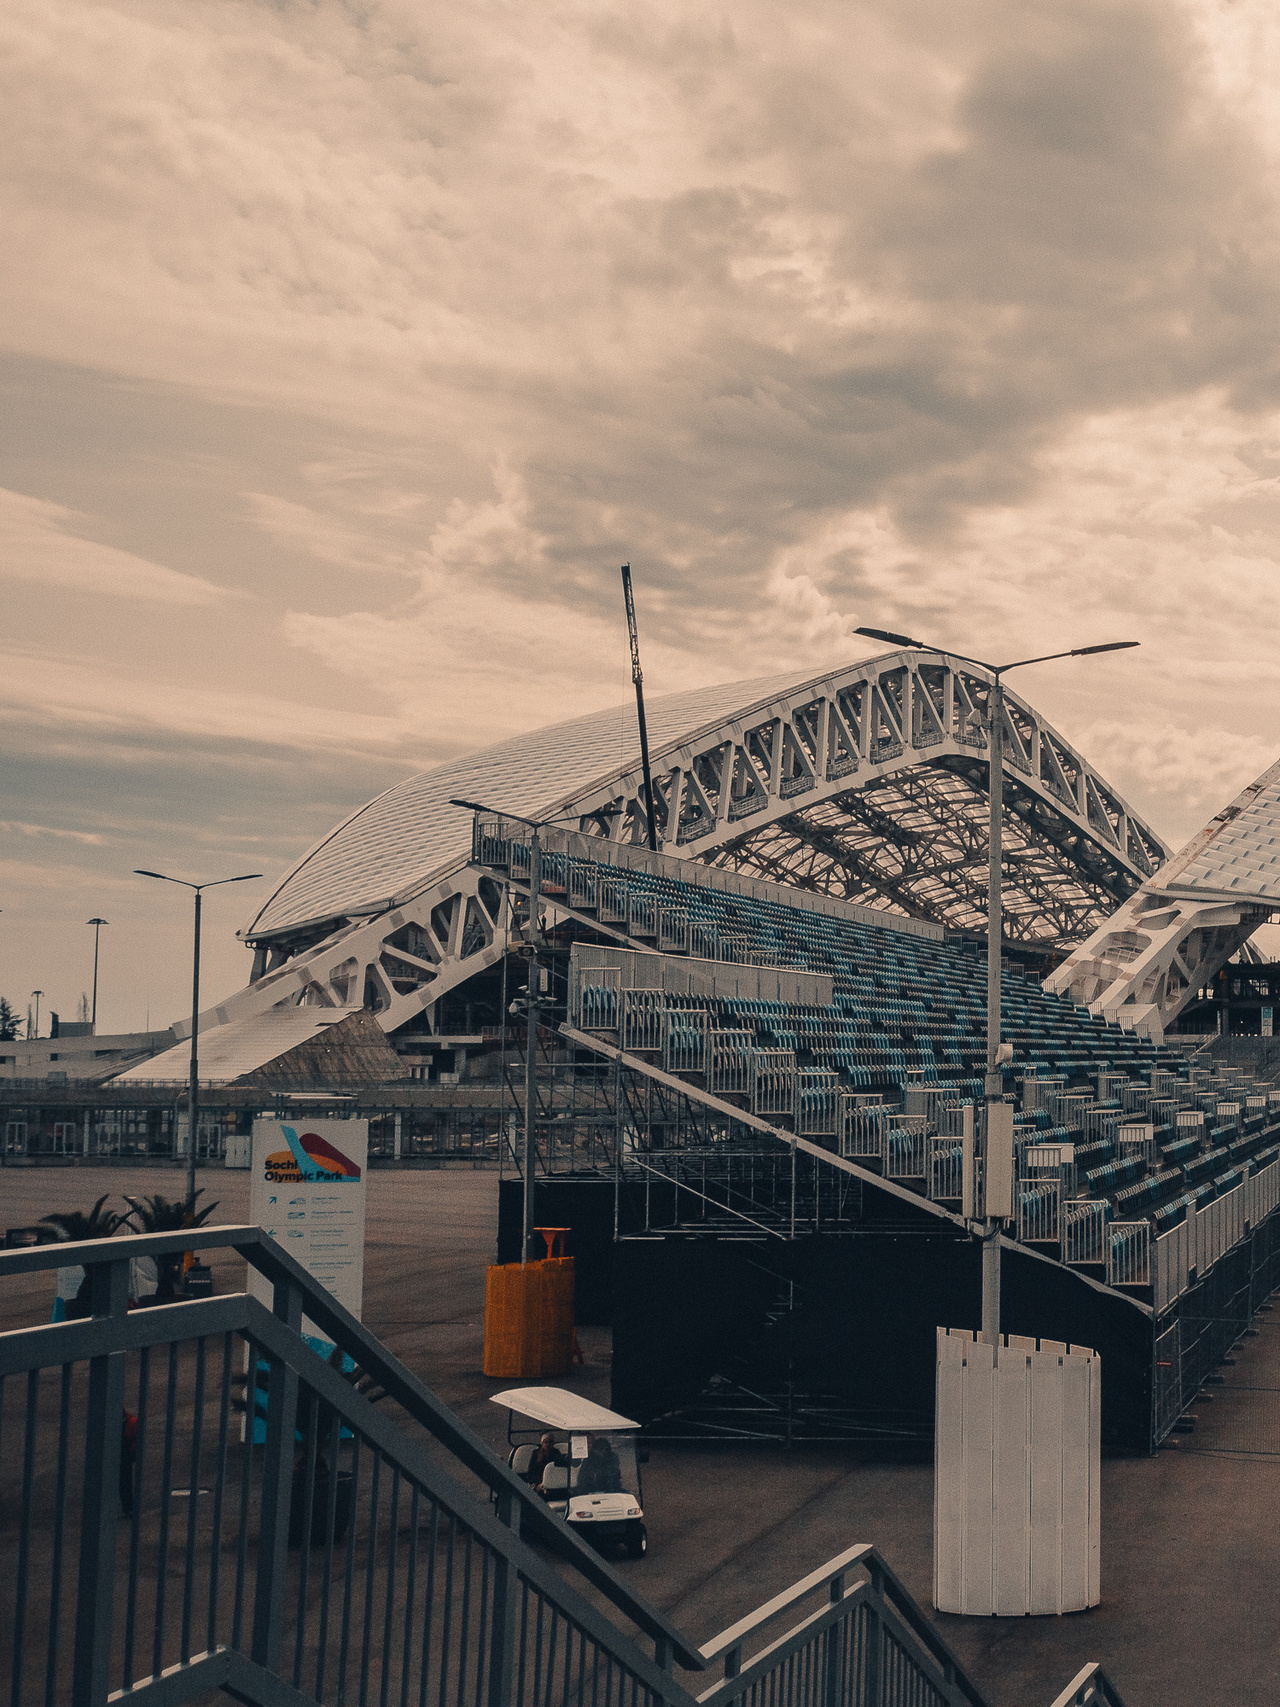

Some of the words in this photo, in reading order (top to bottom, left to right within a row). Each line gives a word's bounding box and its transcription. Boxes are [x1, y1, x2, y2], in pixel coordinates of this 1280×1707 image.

[264, 1159, 298, 1170] Sochi
[264, 1171, 314, 1183] Olympic
[316, 1171, 342, 1181] Park
